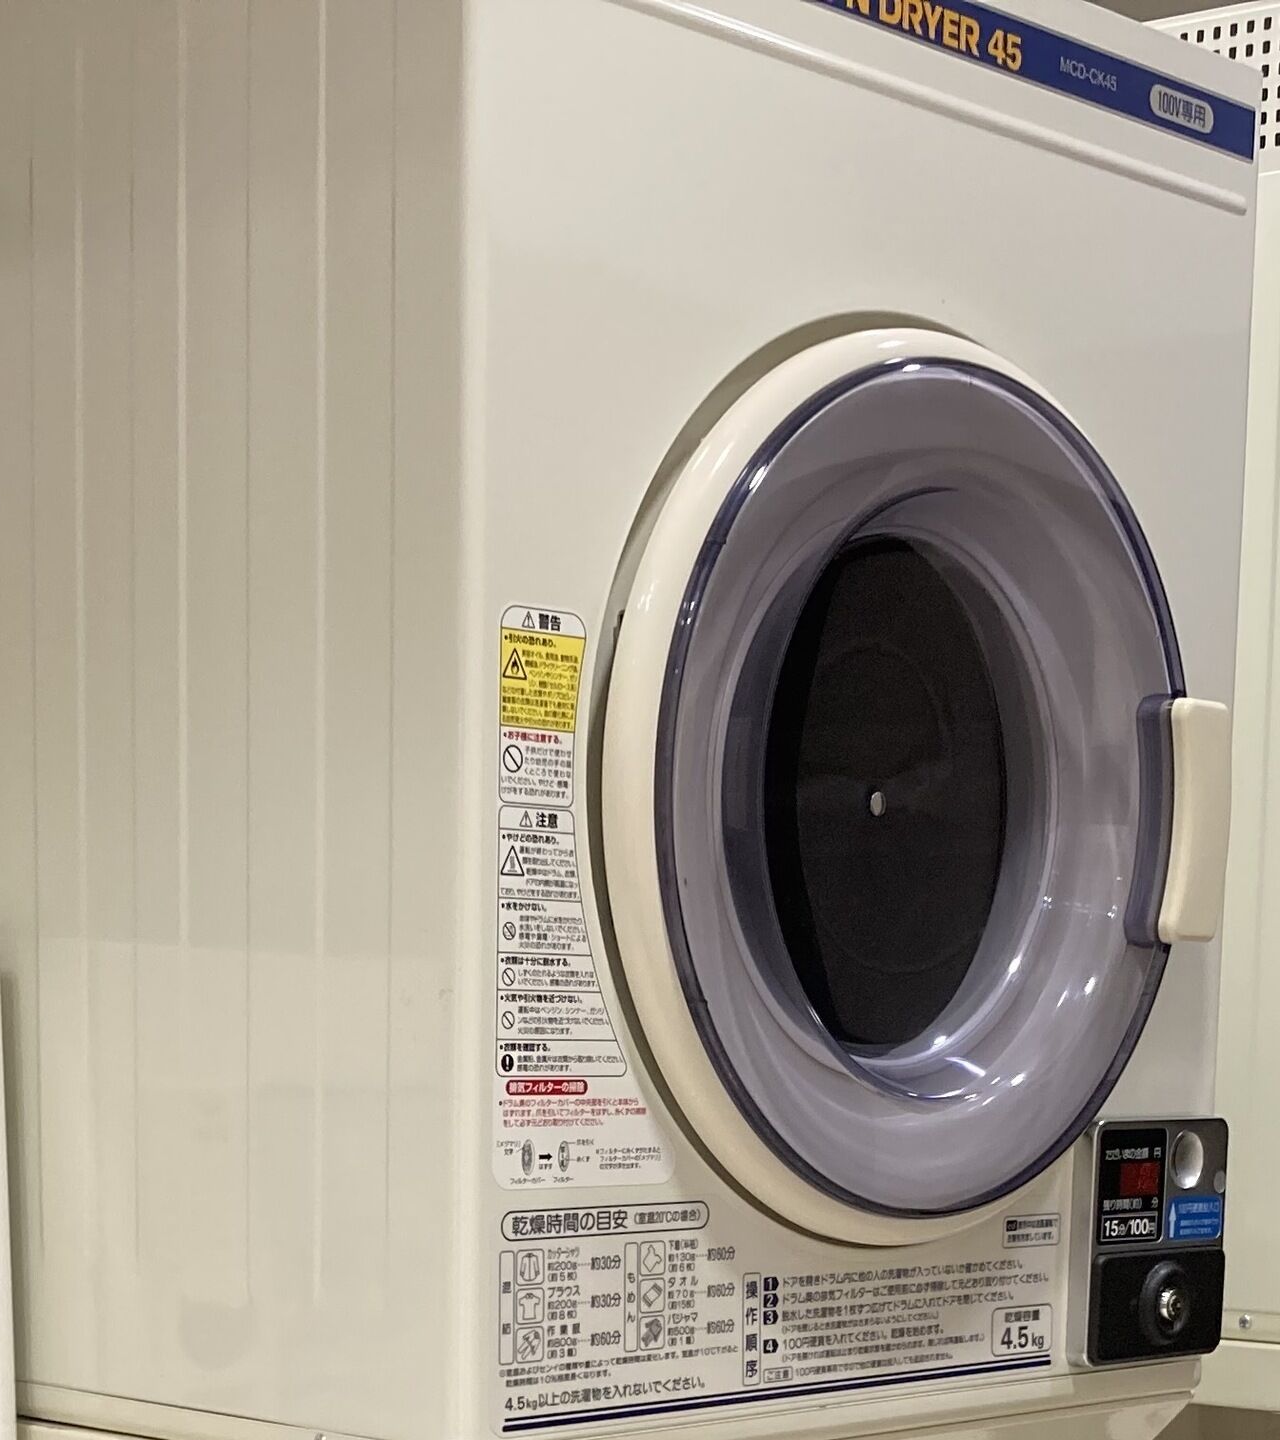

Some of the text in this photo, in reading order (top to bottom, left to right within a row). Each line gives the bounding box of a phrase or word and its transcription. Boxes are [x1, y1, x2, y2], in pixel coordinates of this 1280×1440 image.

[879, 0, 1022, 71] DRYER 45
[535, 812, 558, 829] 注意
[511, 1210, 628, 1237] 乾燥時間の目安
[744, 1279, 758, 1379] 操作順序
